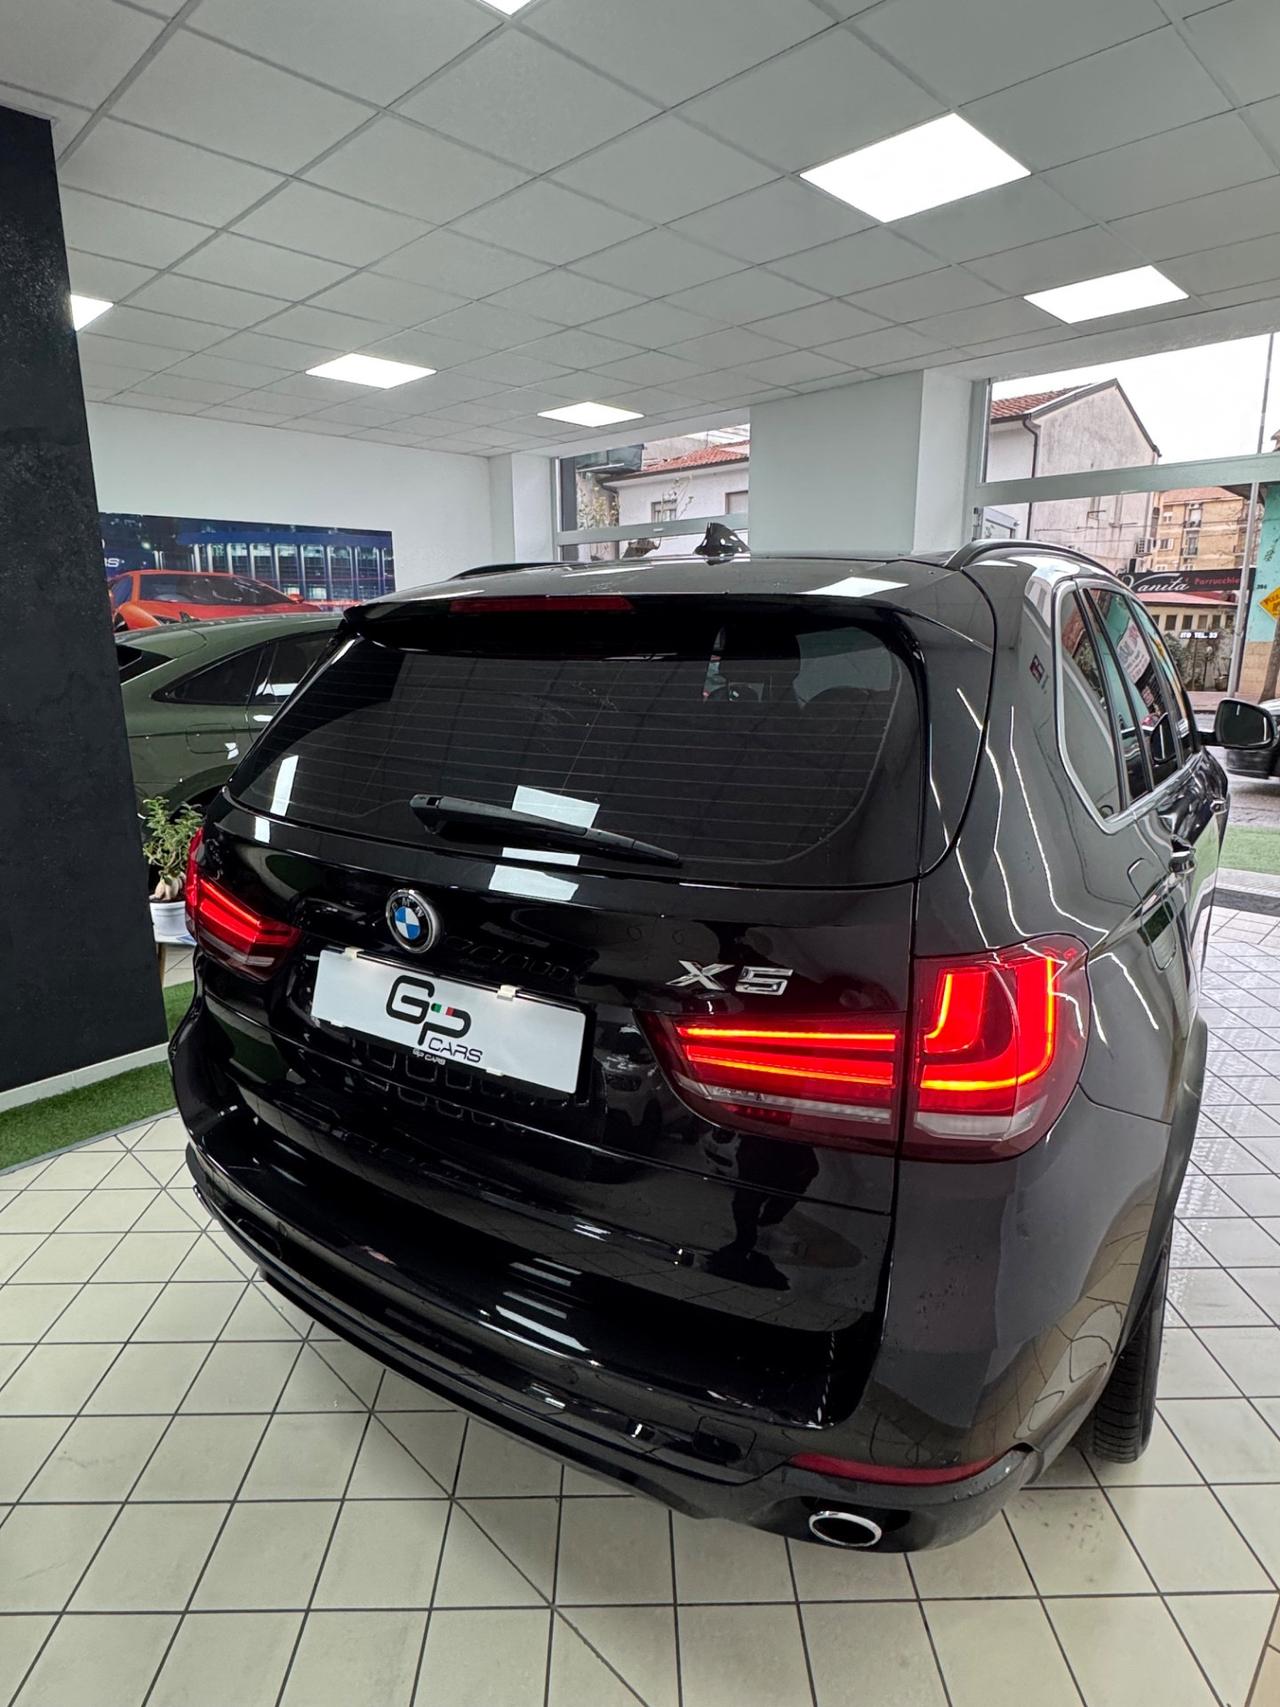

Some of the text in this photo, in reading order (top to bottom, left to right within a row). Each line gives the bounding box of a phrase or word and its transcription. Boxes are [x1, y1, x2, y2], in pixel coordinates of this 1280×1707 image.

[391, 896, 425, 917] BMW
[665, 959, 794, 996] X5
[386, 974, 472, 1046] GP
[428, 1036, 483, 1064] CARS
